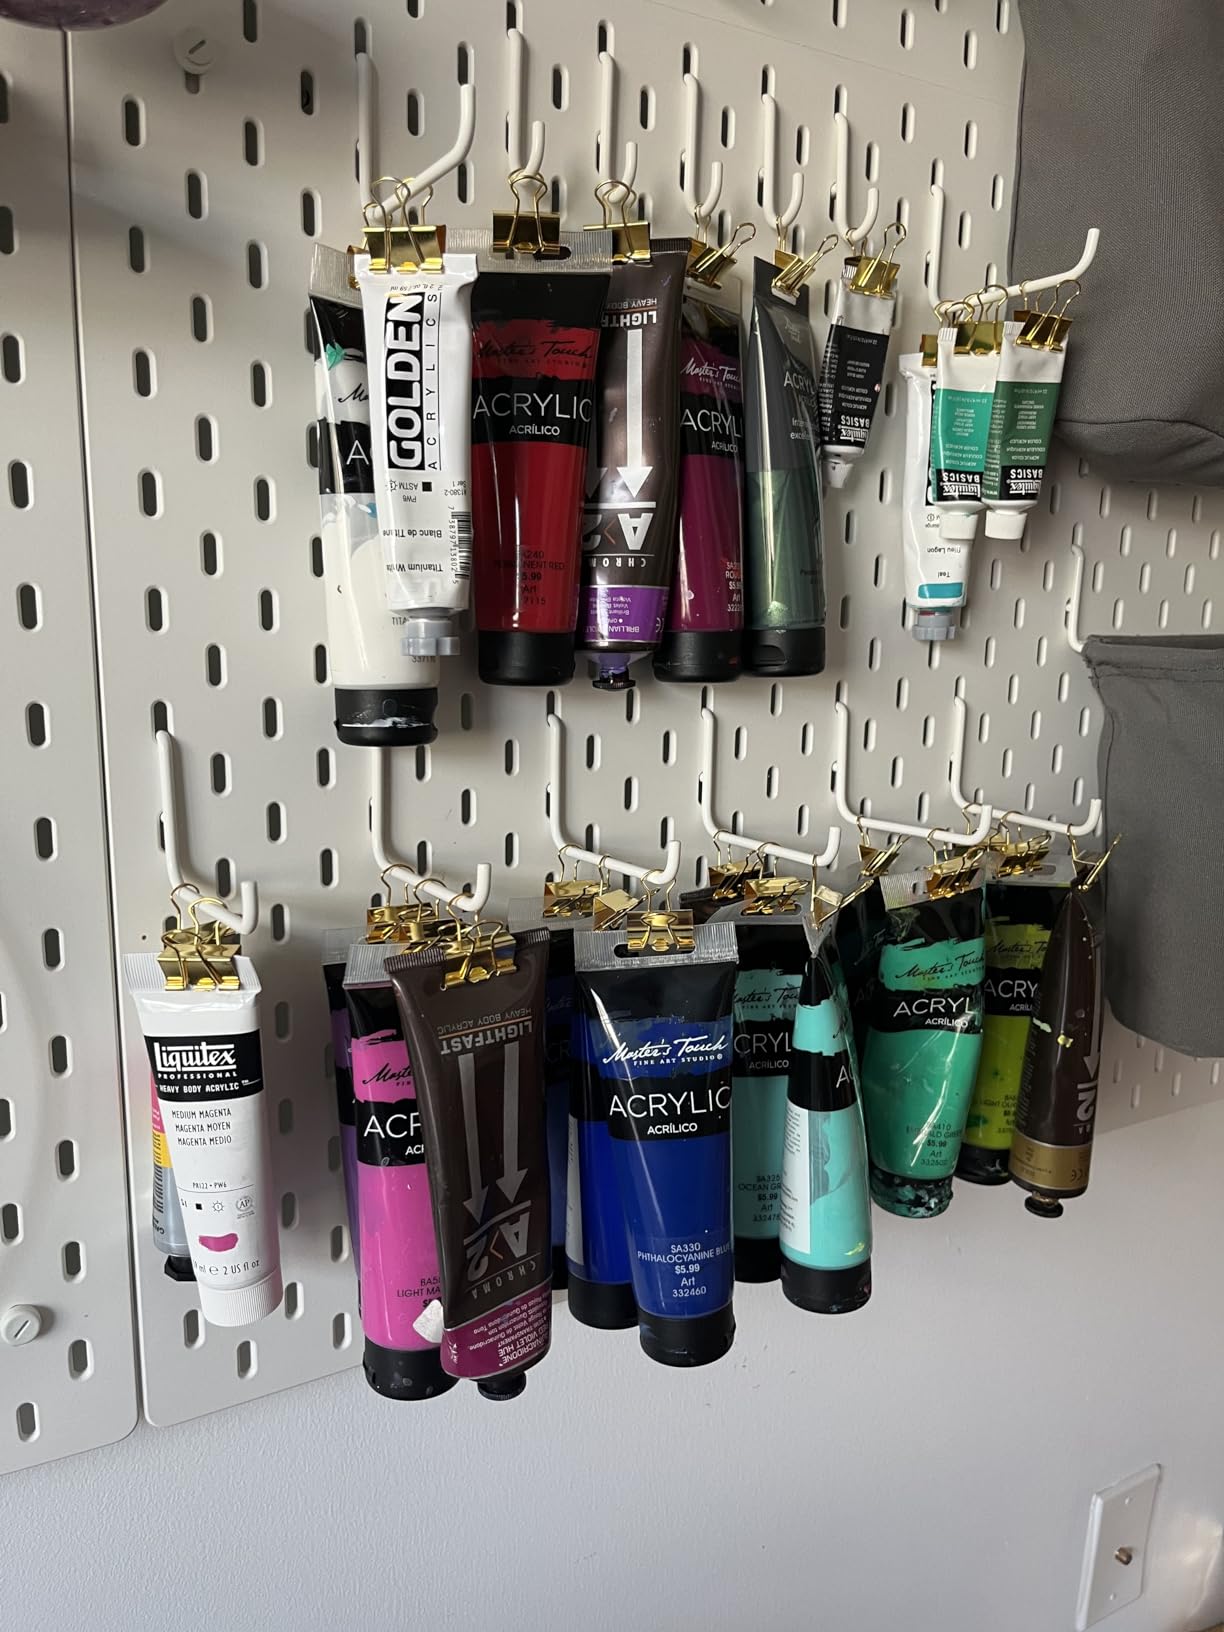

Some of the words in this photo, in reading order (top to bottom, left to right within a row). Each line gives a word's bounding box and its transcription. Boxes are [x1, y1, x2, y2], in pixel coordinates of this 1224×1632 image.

[600, 310, 657, 327] LIGHTF
[385, 293, 424, 468] GOLDEN
[427, 293, 438, 470] ACRYLICS
[473, 393, 592, 422] ACRYLIC
[840, 415, 870, 428] BASICS
[840, 426, 869, 442] iquitex
[943, 472, 980, 483] BASICS
[1010, 468, 1043, 479] BASICS
[943, 483, 981, 497] Liquitex
[1010, 480, 1041, 495] iquitex
[407, 530, 417, 538] de
[419, 529, 442, 538] Blanc
[407, 563, 443, 572] Titanium
[607, 625, 640, 633] BRILLIAN
[895, 959, 953, 979] Master's
[504, 1007, 532, 1020] HEAVY
[893, 997, 978, 1018] ACRYL
[437, 1017, 474, 1034] ACRYLIC
[477, 1012, 501, 1026] BODY
[440, 1020, 533, 1055] LIGHTFAST
[603, 1039, 672, 1064] Master's
[673, 1034, 729, 1057] Touch
[154, 1042, 237, 1072] Liquitex
[633, 1058, 654, 1066] FINE
[158, 1072, 238, 1080] PROFESSIONAL
[160, 1085, 180, 1094] HEAVY
[183, 1085, 202, 1093] BODY
[205, 1082, 240, 1092] ACRYLIC
[609, 1086, 731, 1118] ACRYLIC
[172, 1109, 197, 1119] MEDIUM
[199, 1108, 232, 1118] MAGENTA
[175, 1123, 205, 1133] MAGENTA
[207, 1122, 231, 1131] MOYEN
[647, 1122, 698, 1135] ACRÍLICO
[177, 1137, 207, 1146] MAGENTA
[209, 1135, 232, 1145] MEDIO
[671, 1242, 701, 1253] SA330
[637, 1250, 715, 1263] PHTHALOCYANINE
[675, 1264, 700, 1275] $5.99
[472, 1260, 536, 1299] CHROMA
[681, 1277, 695, 1287] Art
[397, 1288, 423, 1298] LIGHT
[672, 1286, 707, 1298] 332460
[516, 1331, 538, 1349] VIOLET
[498, 1345, 515, 1357] HUE
